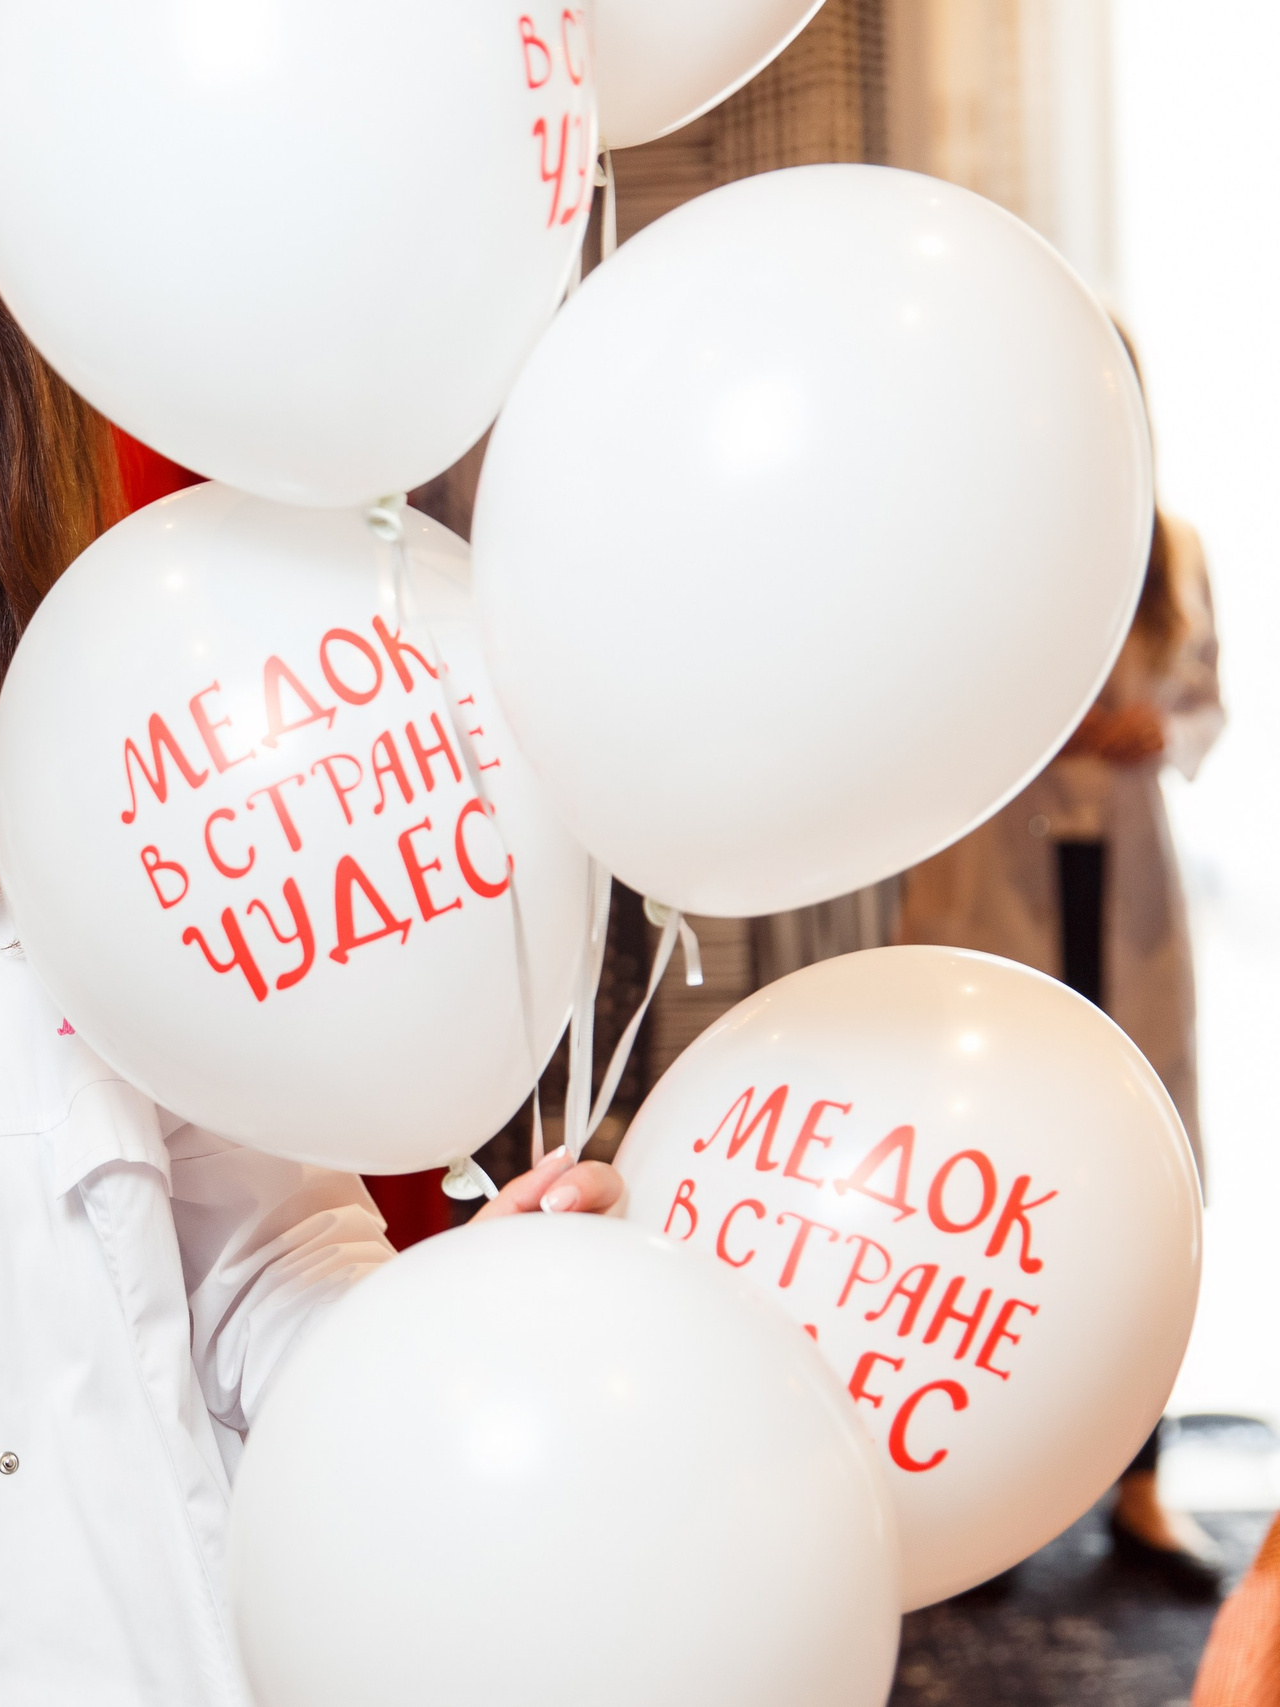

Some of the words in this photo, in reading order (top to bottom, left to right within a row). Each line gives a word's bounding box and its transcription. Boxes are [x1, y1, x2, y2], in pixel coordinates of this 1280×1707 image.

[517, 13, 553, 90] В
[120, 614, 450, 826] МЕДОК
[139, 844, 191, 911] В
[202, 692, 502, 881] СТРАН
[180, 795, 516, 1004] ЧУДЕС
[662, 1177, 700, 1242] В
[715, 1197, 1042, 1383] СТРАНЕ
[692, 1083, 1060, 1276] МЕДОК
